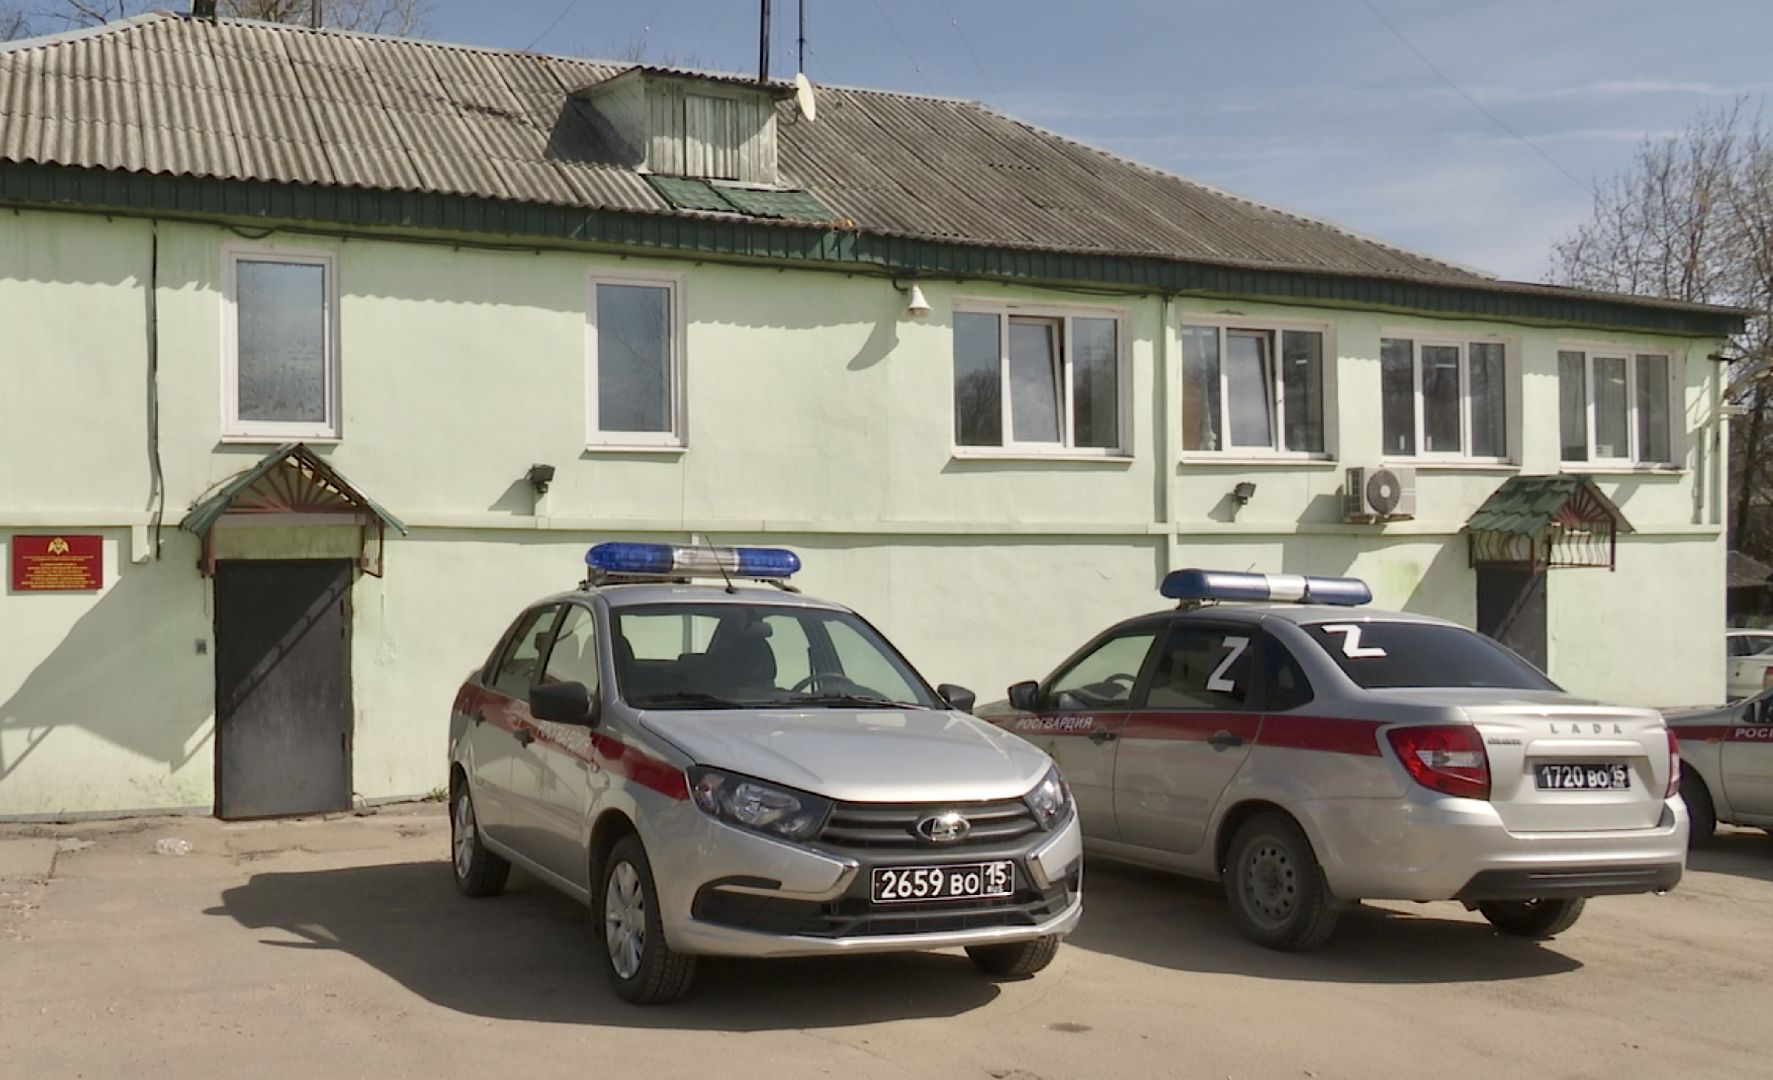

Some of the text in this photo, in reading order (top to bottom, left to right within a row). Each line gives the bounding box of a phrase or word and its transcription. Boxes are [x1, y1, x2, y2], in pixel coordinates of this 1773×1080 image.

[1320, 624, 1387, 658] Z
[1206, 636, 1250, 692] Z
[1016, 716, 1094, 731] РОСГВАРДИЯ
[1549, 723, 1622, 734] LADA
[1542, 766, 1584, 788] 1720
[881, 868, 944, 898] 2659
[985, 863, 1006, 885] 15
